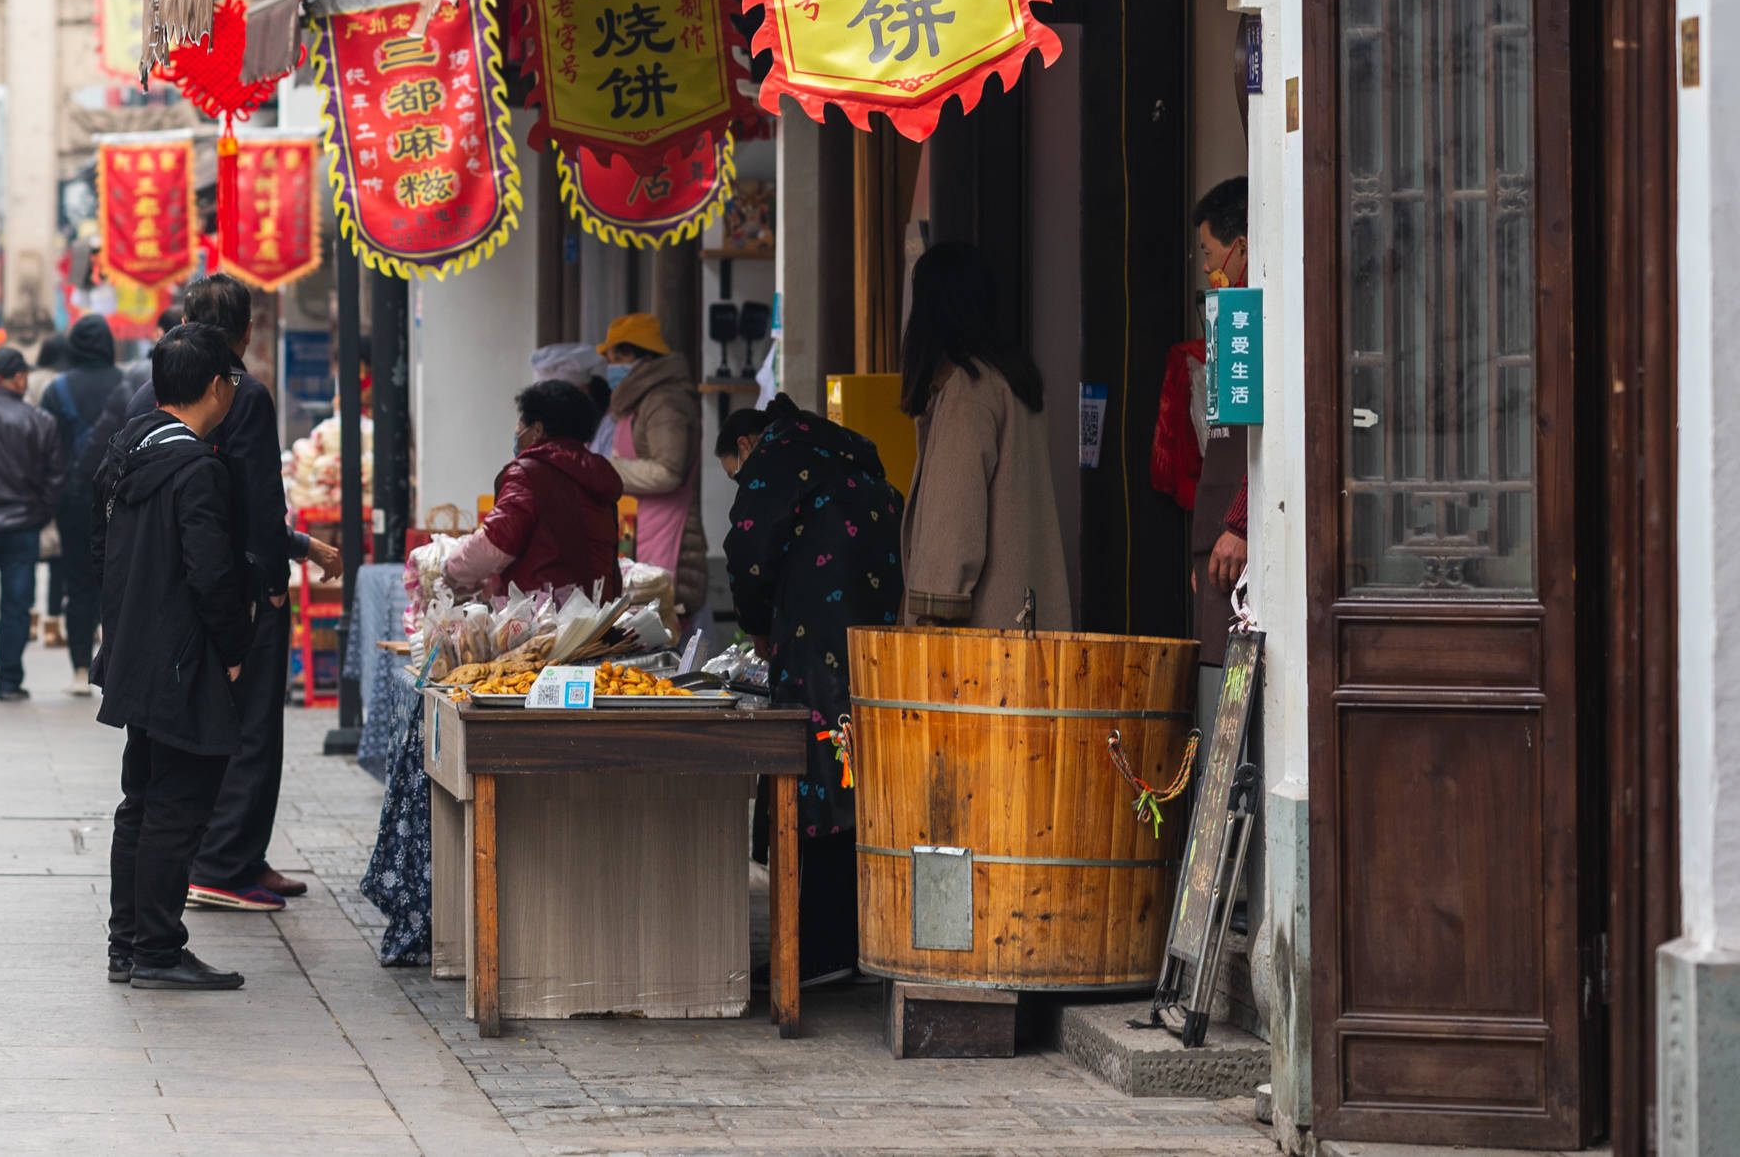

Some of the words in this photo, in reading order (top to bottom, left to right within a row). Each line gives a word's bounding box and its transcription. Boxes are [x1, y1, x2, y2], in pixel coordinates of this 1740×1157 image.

[345, 5, 460, 39] 严州老号
[344, 67, 384, 196] 纯手工制作
[377, 36, 456, 208] 三都麻糍
[1230, 310, 1250, 405] 享受生活
